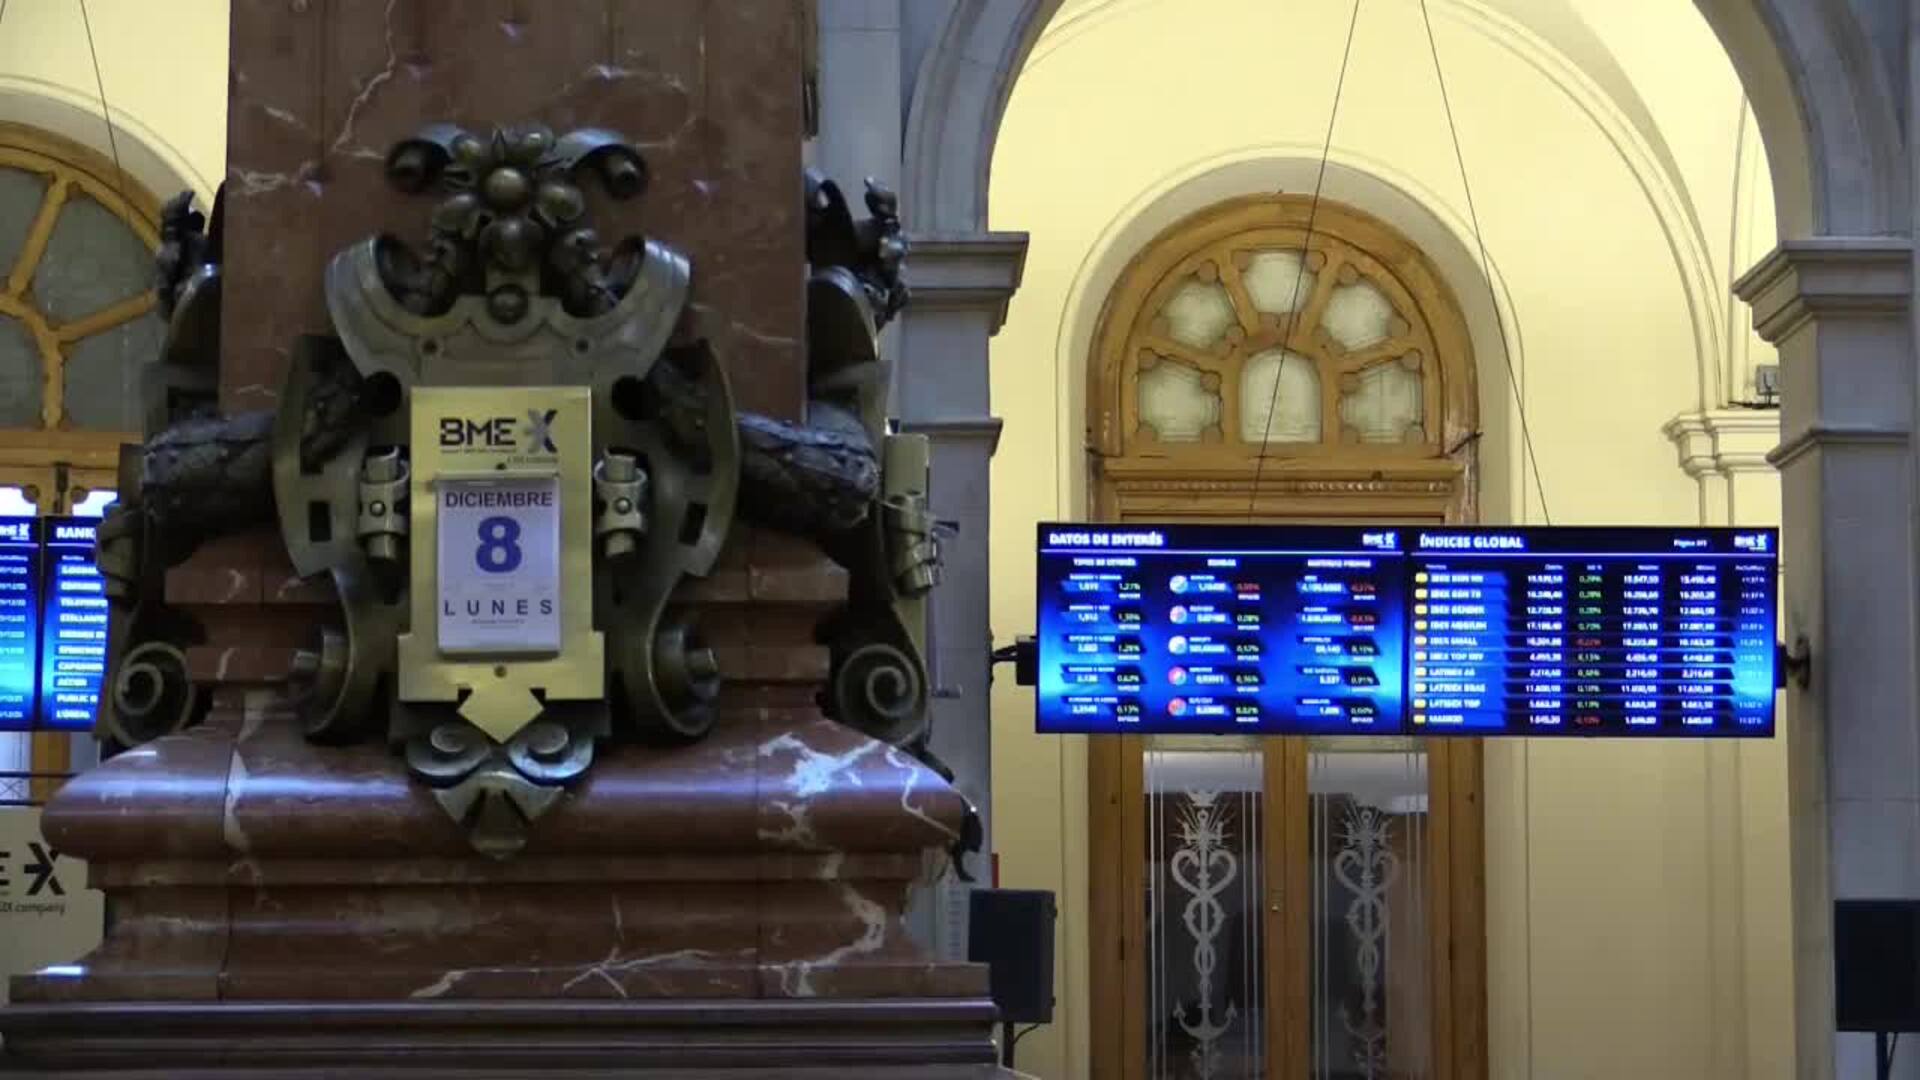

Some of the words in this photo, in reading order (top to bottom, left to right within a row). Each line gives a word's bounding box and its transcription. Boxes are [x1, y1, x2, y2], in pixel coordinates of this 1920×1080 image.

[440, 418, 517, 446] BME
[445, 491, 553, 508] DICIEMBRE
[475, 516, 522, 573] 8
[1049, 533, 1091, 545] DATOS
[1092, 533, 1109, 546] DE
[1111, 531, 1164, 546] INTERÉS
[1419, 533, 1471, 548] ÍNDICES
[1473, 535, 1524, 548] GLOBAL
